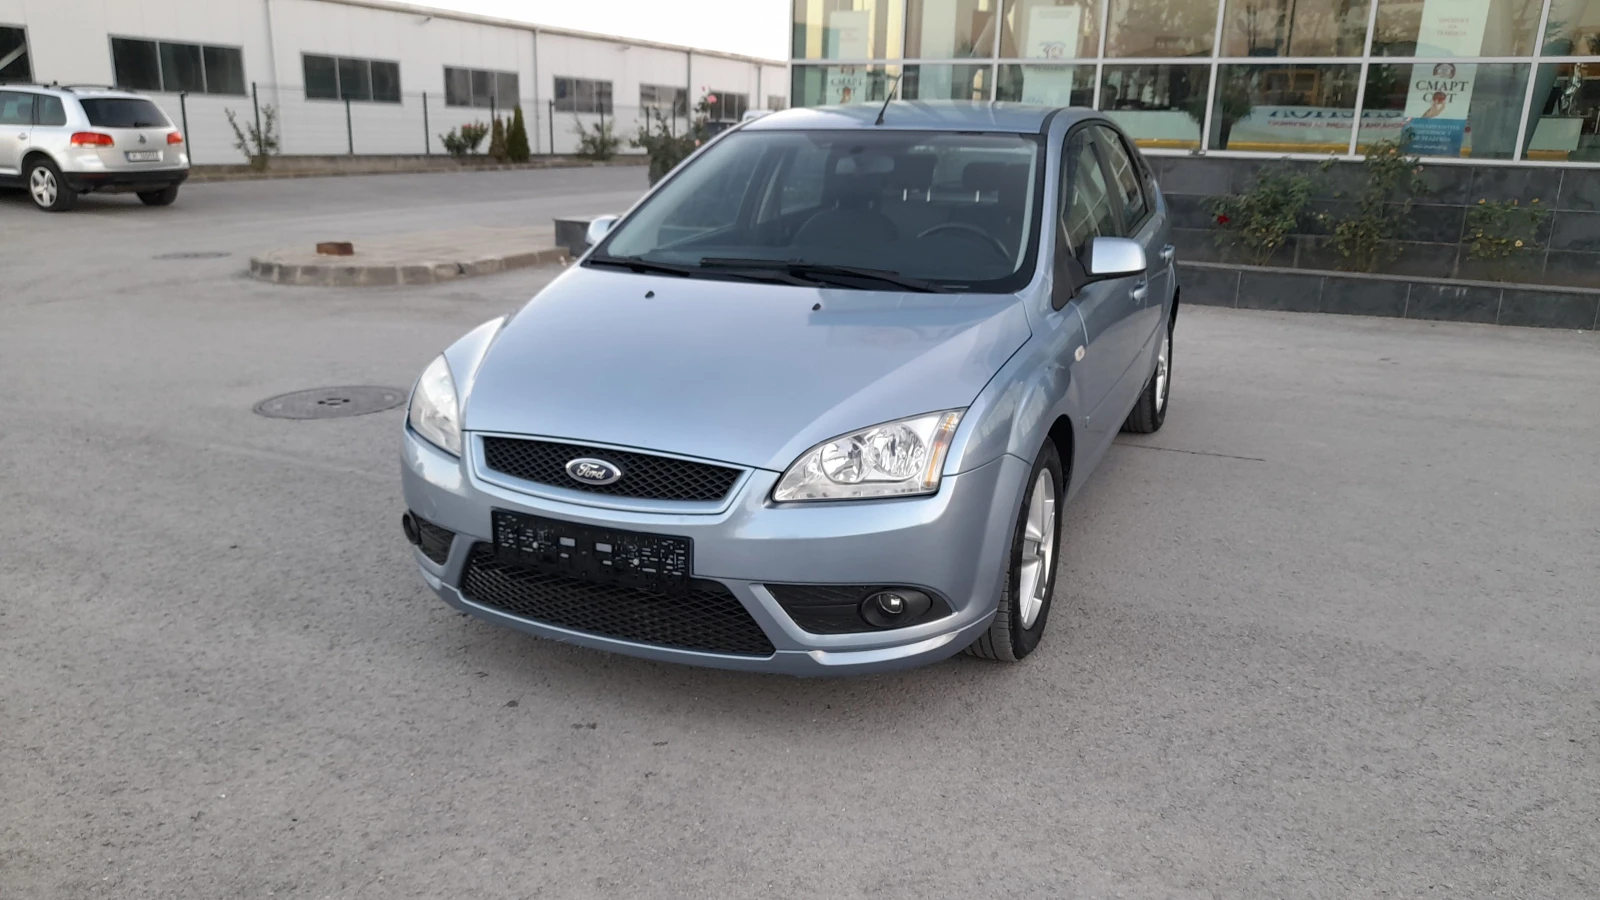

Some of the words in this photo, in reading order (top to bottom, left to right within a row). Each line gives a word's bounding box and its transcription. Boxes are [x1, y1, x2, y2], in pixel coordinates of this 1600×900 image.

[1415, 80, 1469, 92] СМАРТ
[1422, 92, 1457, 103] СТ
[576, 462, 606, 480] Ford
